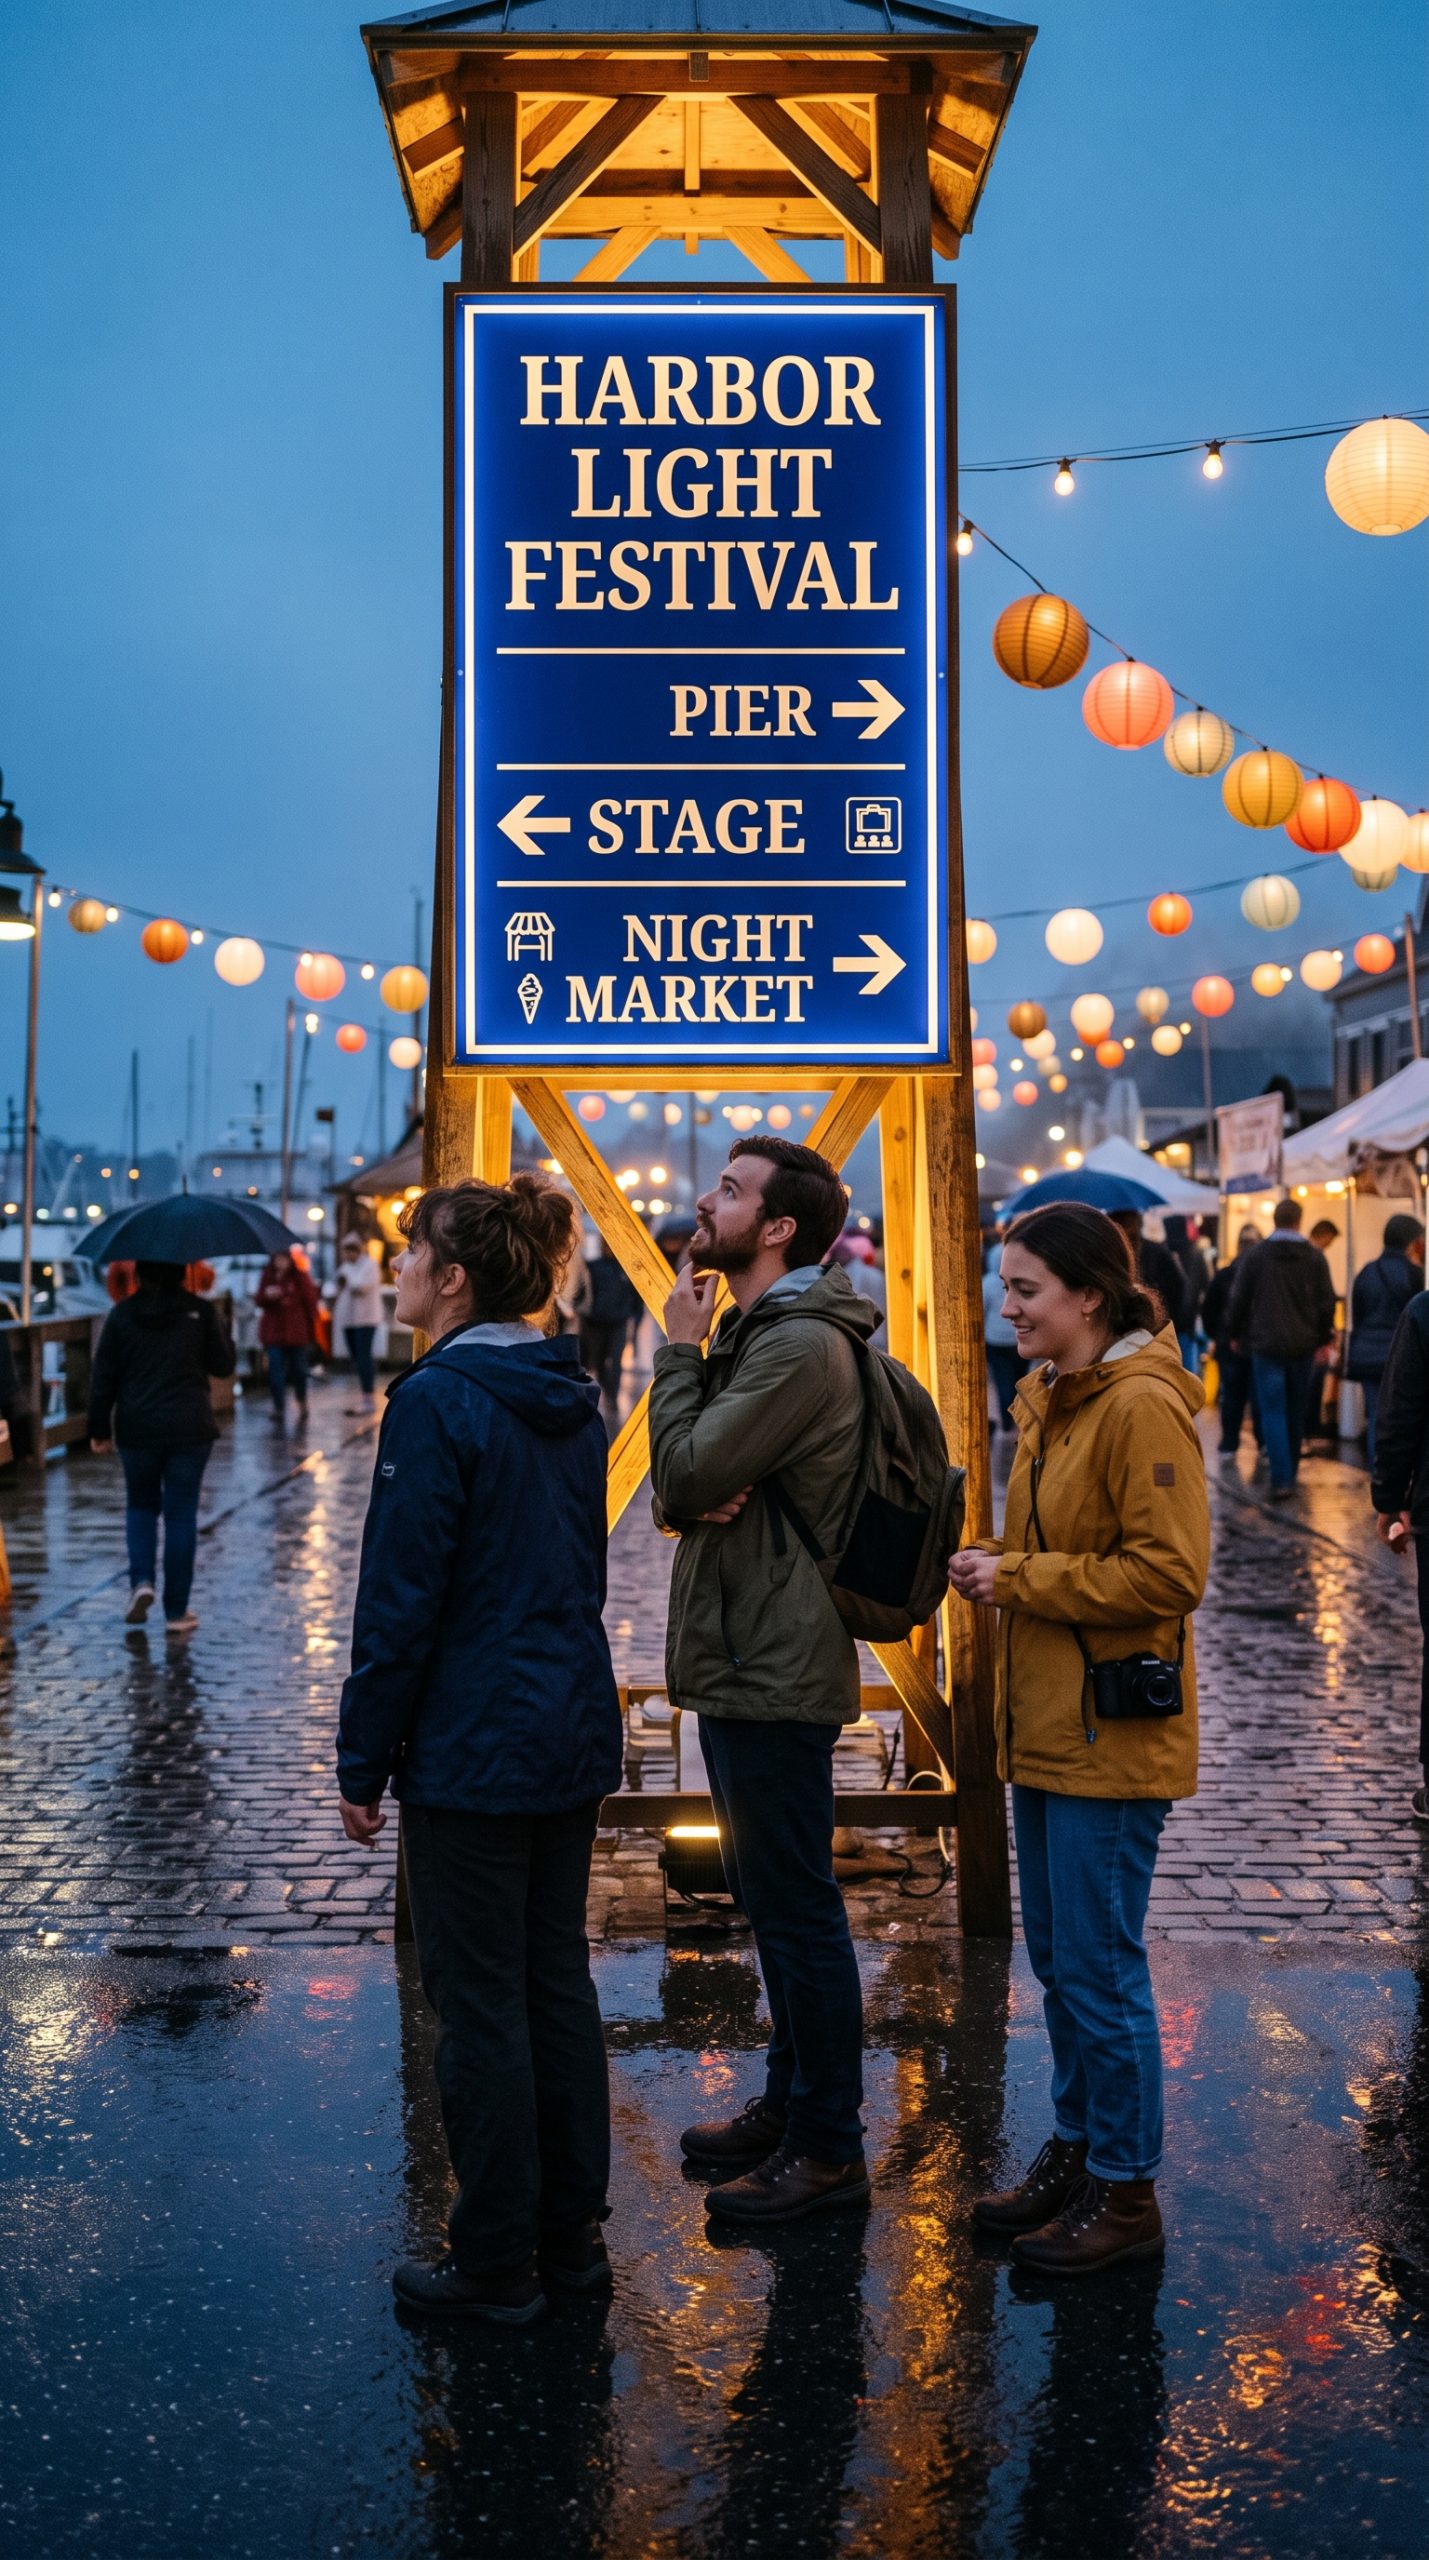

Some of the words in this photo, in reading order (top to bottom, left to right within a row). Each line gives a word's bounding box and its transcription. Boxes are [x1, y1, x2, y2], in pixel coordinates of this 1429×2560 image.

[519, 355, 882, 427] HARBOR
[571, 447, 834, 519] LIGHT
[503, 540, 899, 611] FESTIVAL
[669, 685, 817, 737] PIER
[588, 798, 806, 855] STAGE
[622, 914, 814, 963] NIGHT
[565, 975, 814, 1023] MARKET
